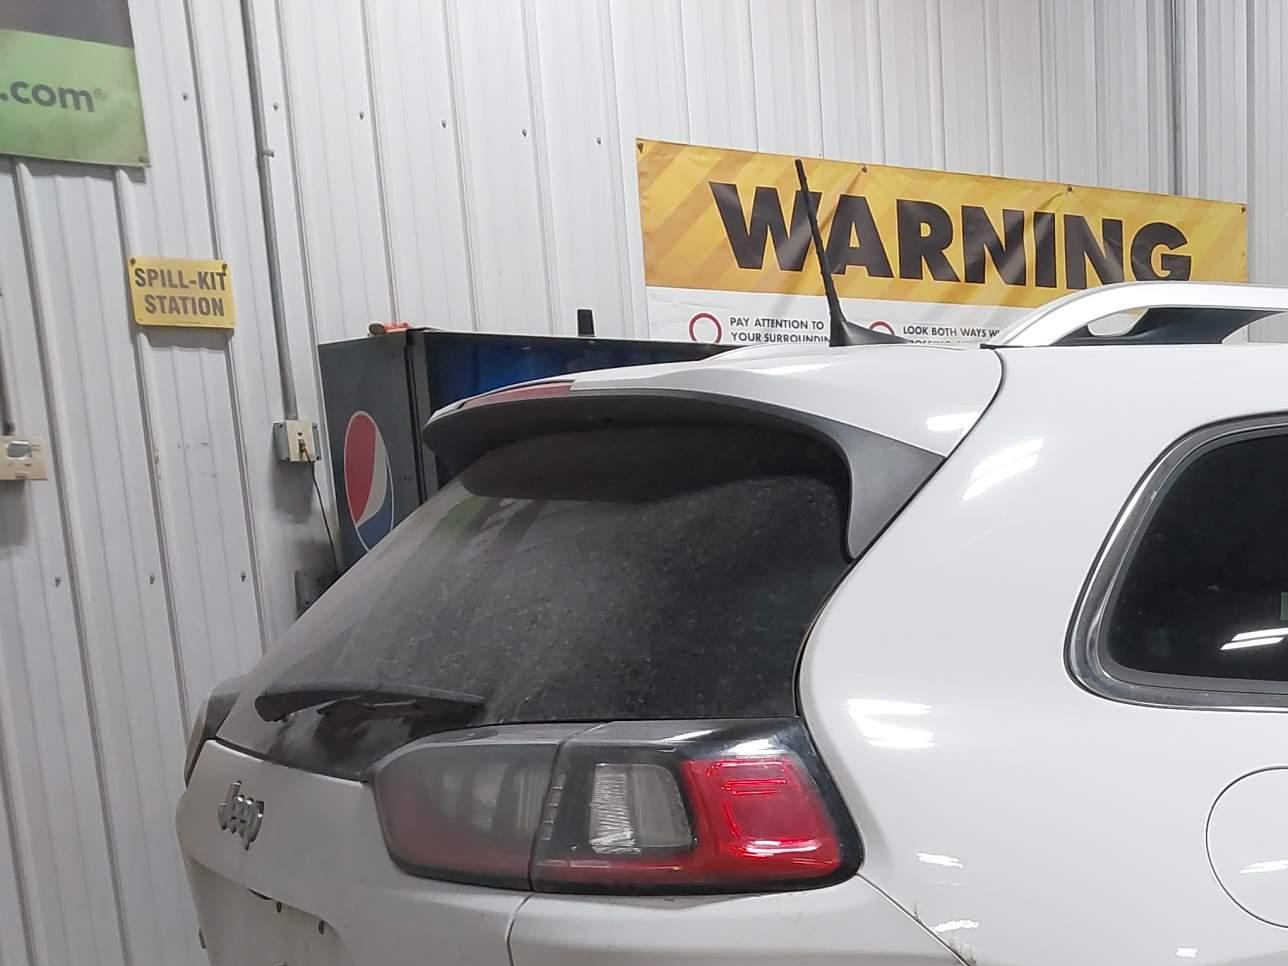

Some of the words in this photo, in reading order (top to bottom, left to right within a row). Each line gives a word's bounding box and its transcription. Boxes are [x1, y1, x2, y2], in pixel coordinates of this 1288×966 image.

[709, 181, 1192, 290] WARNING
[134, 267, 227, 291] SPILL-KIT
[144, 294, 225, 317] STATION
[730, 317, 750, 327] PAY
[754, 318, 809, 330] ATTENTION
[811, 320, 825, 331] TO
[903, 325, 929, 336] LOOK
[931, 327, 958, 337] BOTH
[959, 328, 987, 339] WAYS
[731, 332, 762, 343] YOUR
[217, 780, 264, 851] Jeep
